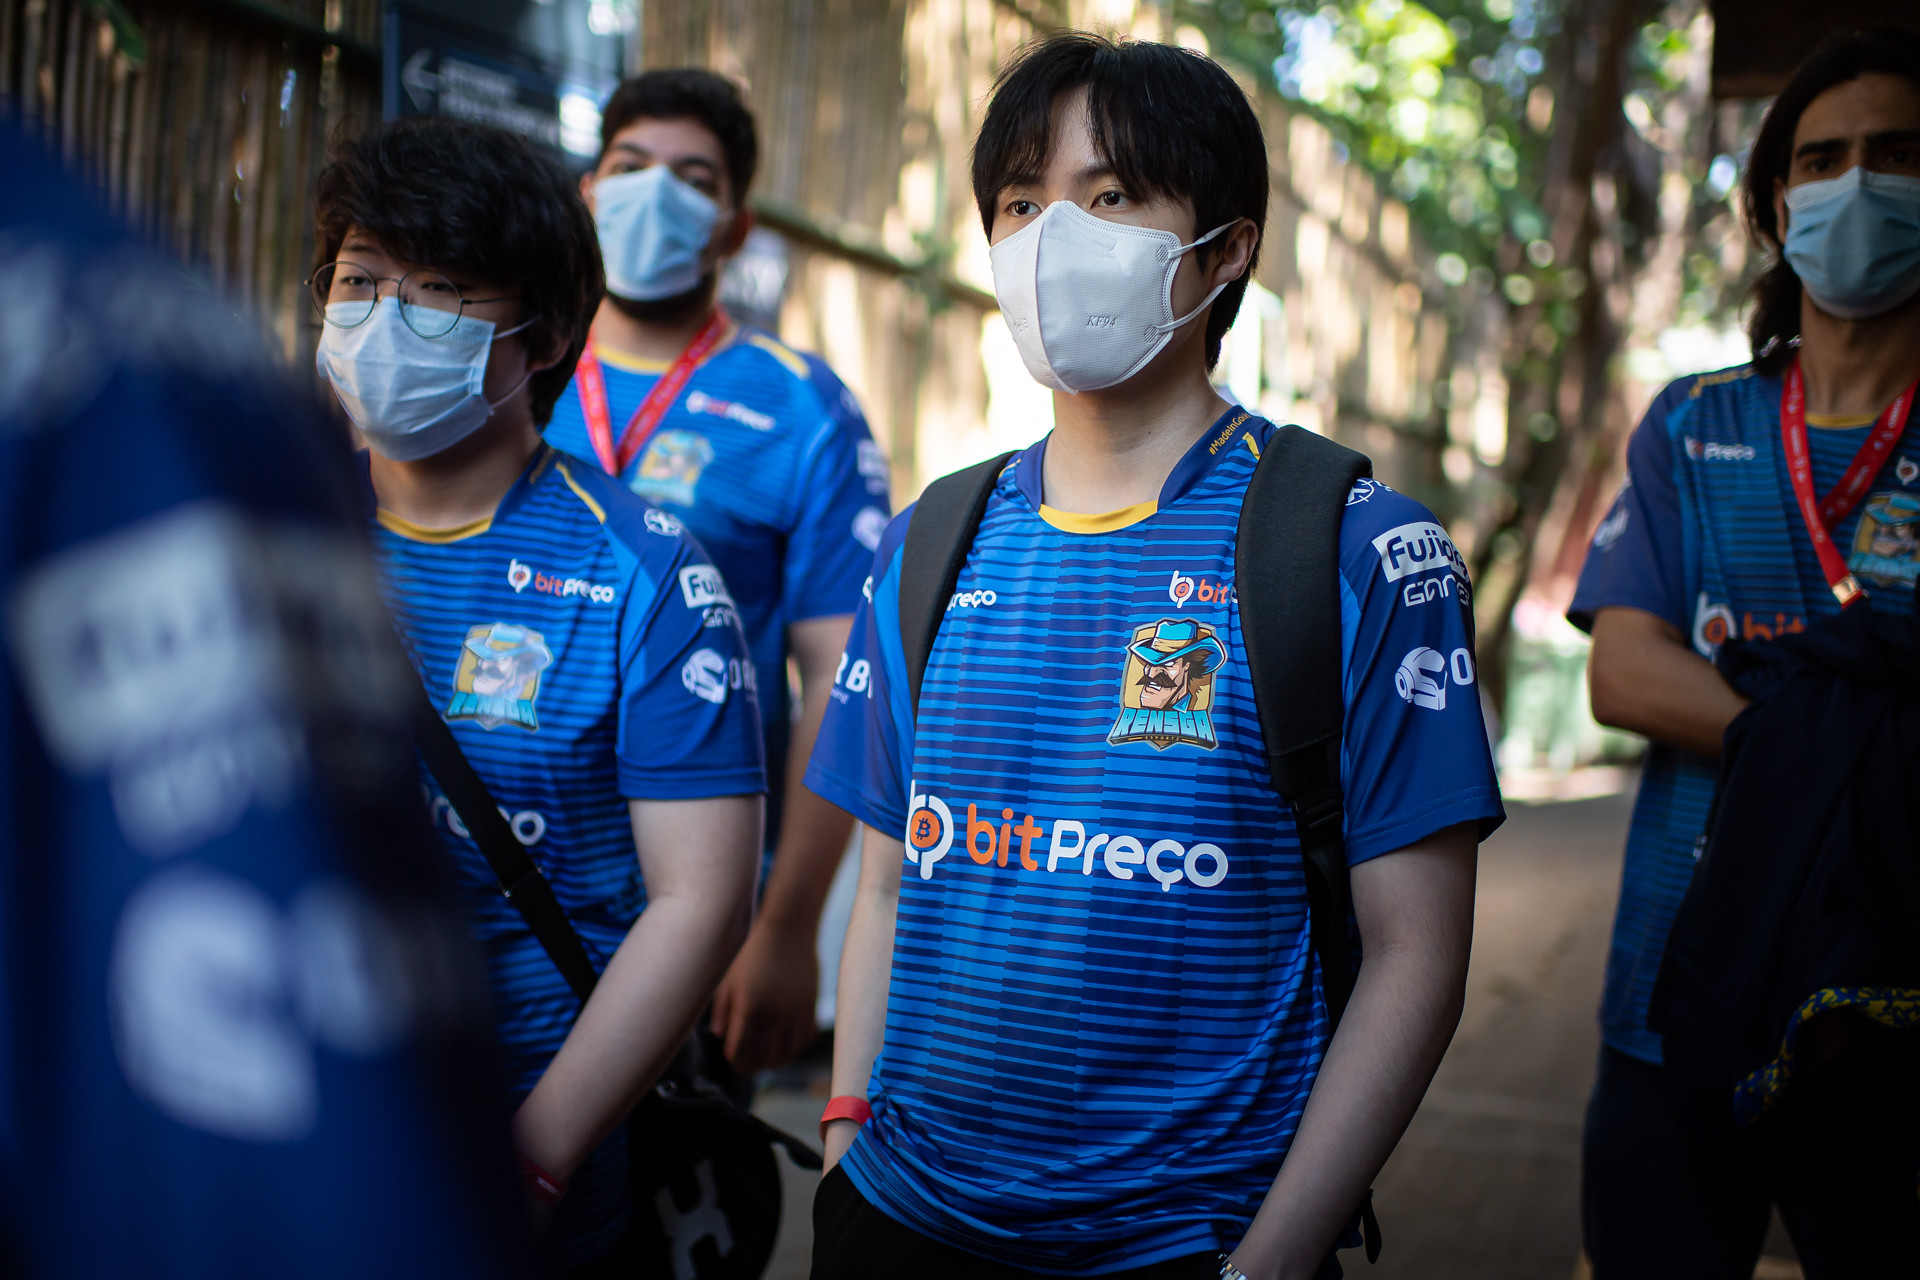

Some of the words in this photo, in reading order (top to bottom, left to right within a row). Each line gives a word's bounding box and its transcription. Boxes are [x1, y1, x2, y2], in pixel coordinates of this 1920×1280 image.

[1086, 315, 1118, 328] KF94
[1111, 707, 1215, 742] RENSGA
[966, 803, 1228, 892] bitPreço
